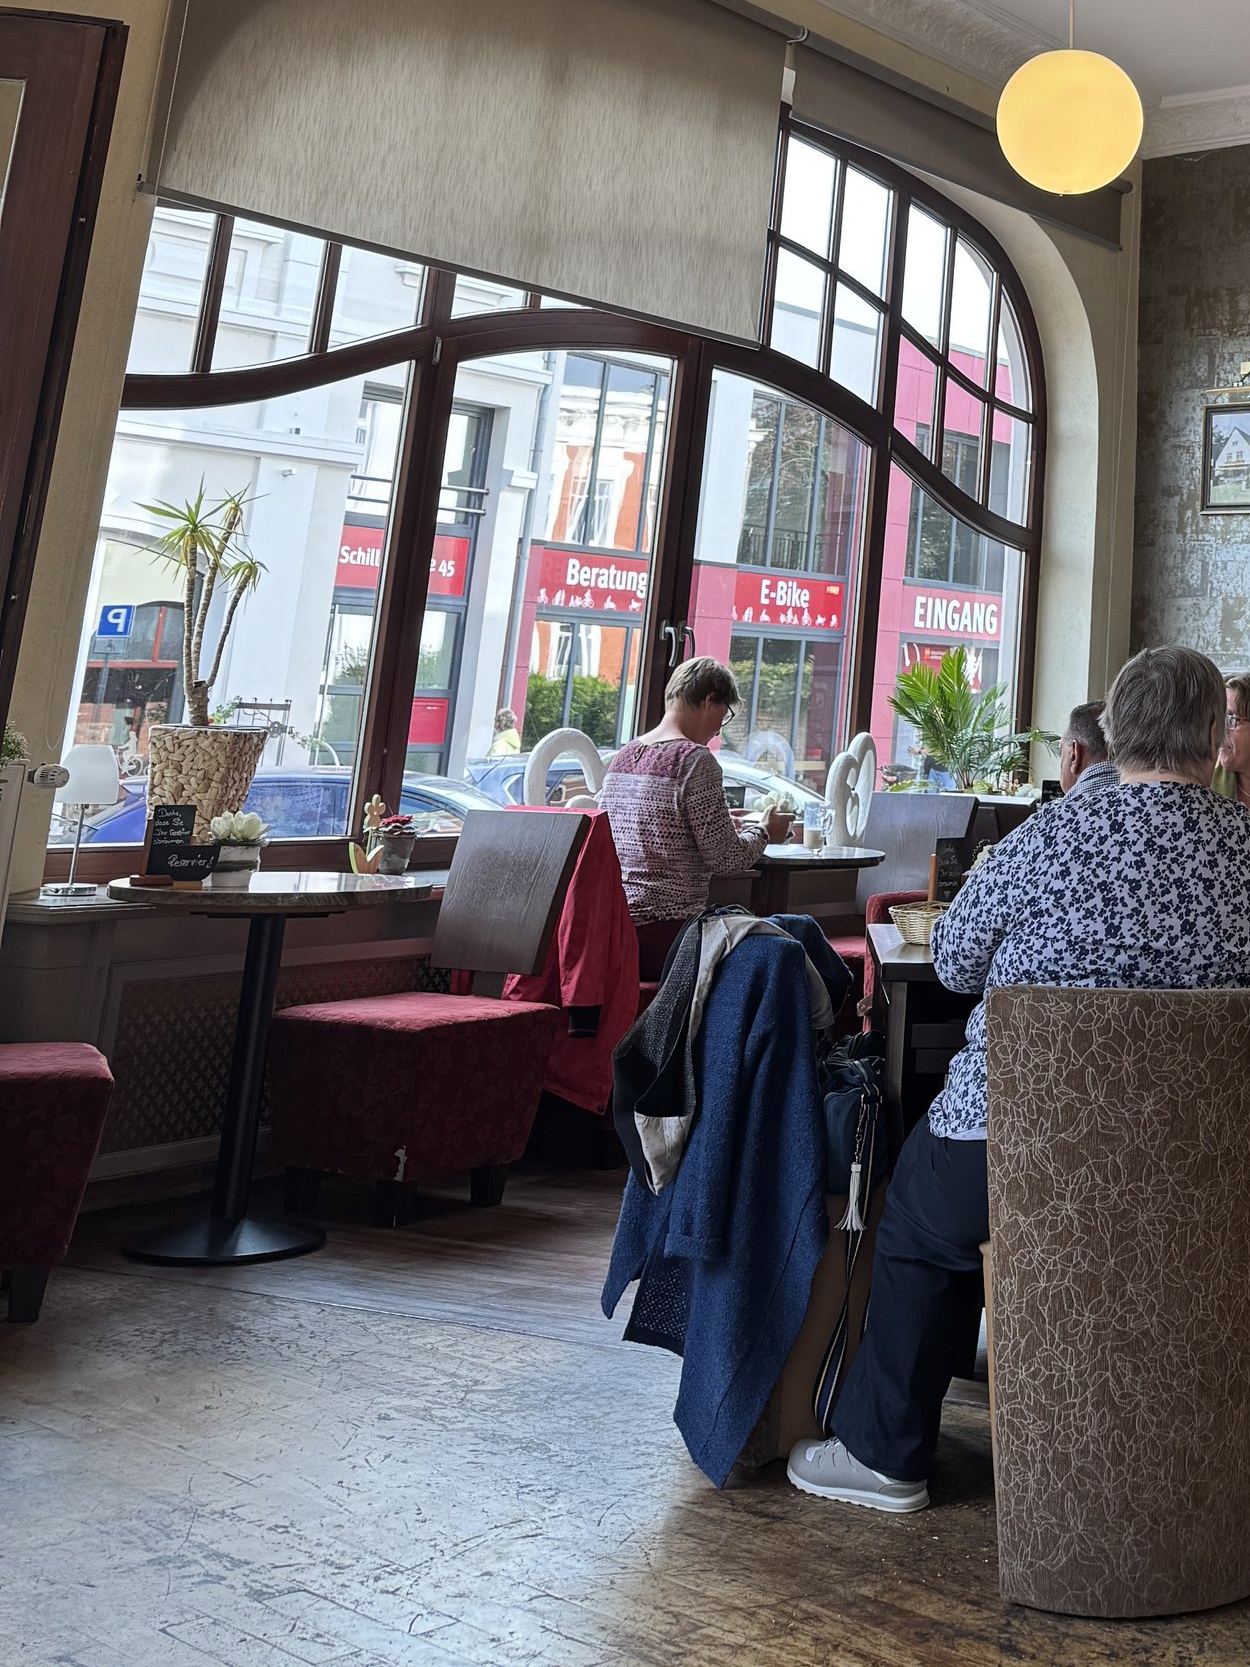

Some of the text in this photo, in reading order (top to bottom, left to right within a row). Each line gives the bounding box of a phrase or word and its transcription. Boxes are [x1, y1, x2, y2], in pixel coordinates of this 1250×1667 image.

[438, 560, 456, 577] 45
[566, 558, 648, 599] Beratung
[760, 579, 810, 608] E-Bike
[914, 596, 998, 634] EINGANG
[172, 817, 184, 826] Sie
